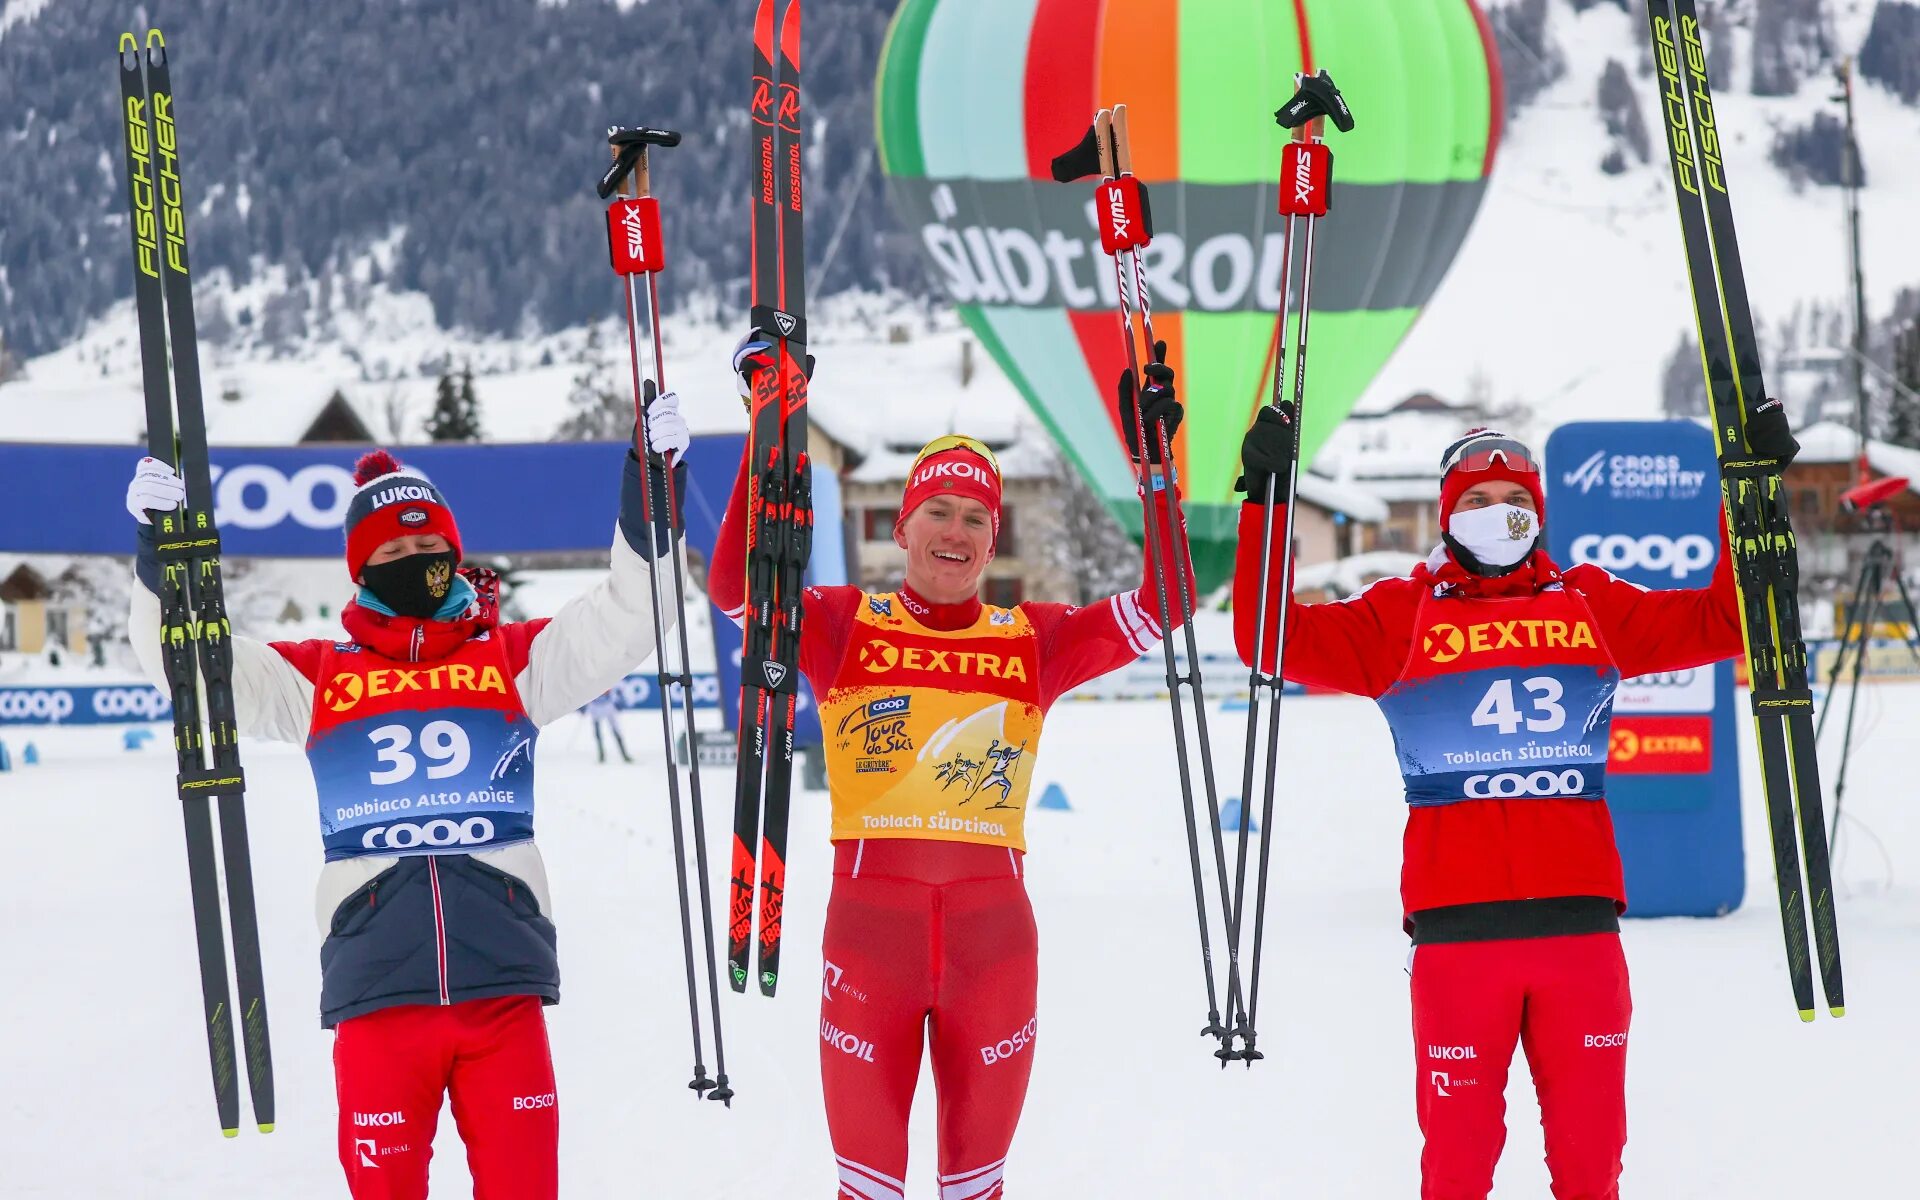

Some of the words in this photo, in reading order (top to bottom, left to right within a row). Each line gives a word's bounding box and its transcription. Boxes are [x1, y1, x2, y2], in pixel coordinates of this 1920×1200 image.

[1655, 15, 1699, 196] FISCHER
[1682, 14, 1727, 195] FISCHER
[762, 136, 774, 206] ROSSIGNOL
[789, 143, 801, 212] ROSSIGNOL
[128, 96, 159, 279] FISCHER
[154, 92, 188, 275] FISCHER
[912, 462, 991, 489] LUKOIL
[1609, 455, 1680, 473] CROSS
[1724, 459, 1778, 469] FISCHER
[1609, 472, 1705, 488] COUNTRY
[371, 486, 438, 509] LUKOIL
[157, 538, 219, 551] FISCHER
[1468, 620, 1598, 653] EXTRA
[902, 647, 1027, 684] EXTRA
[367, 664, 507, 697] EXTRA
[872, 699, 905, 711] coop
[1471, 676, 1567, 734] 43
[1758, 699, 1812, 708] FISCHER
[367, 720, 471, 785] 39
[1443, 748, 1513, 765] Toblach
[181, 777, 242, 790] FISCHER
[336, 797, 411, 821] Dobbiaco
[862, 815, 923, 828] Toblach
[730, 918, 751, 943] 188
[760, 922, 781, 947] 188
[840, 982, 868, 1004] RUSAL
[820, 1017, 875, 1063] LUKOIL
[1584, 1033, 1624, 1048] BOSCO
[1428, 1044, 1478, 1060] LUKOIL
[1452, 1077, 1479, 1087] RUSAL
[513, 1093, 554, 1110] BOSCO
[353, 1110, 406, 1127] LUKOIL
[381, 1143, 411, 1156] RUSAL
